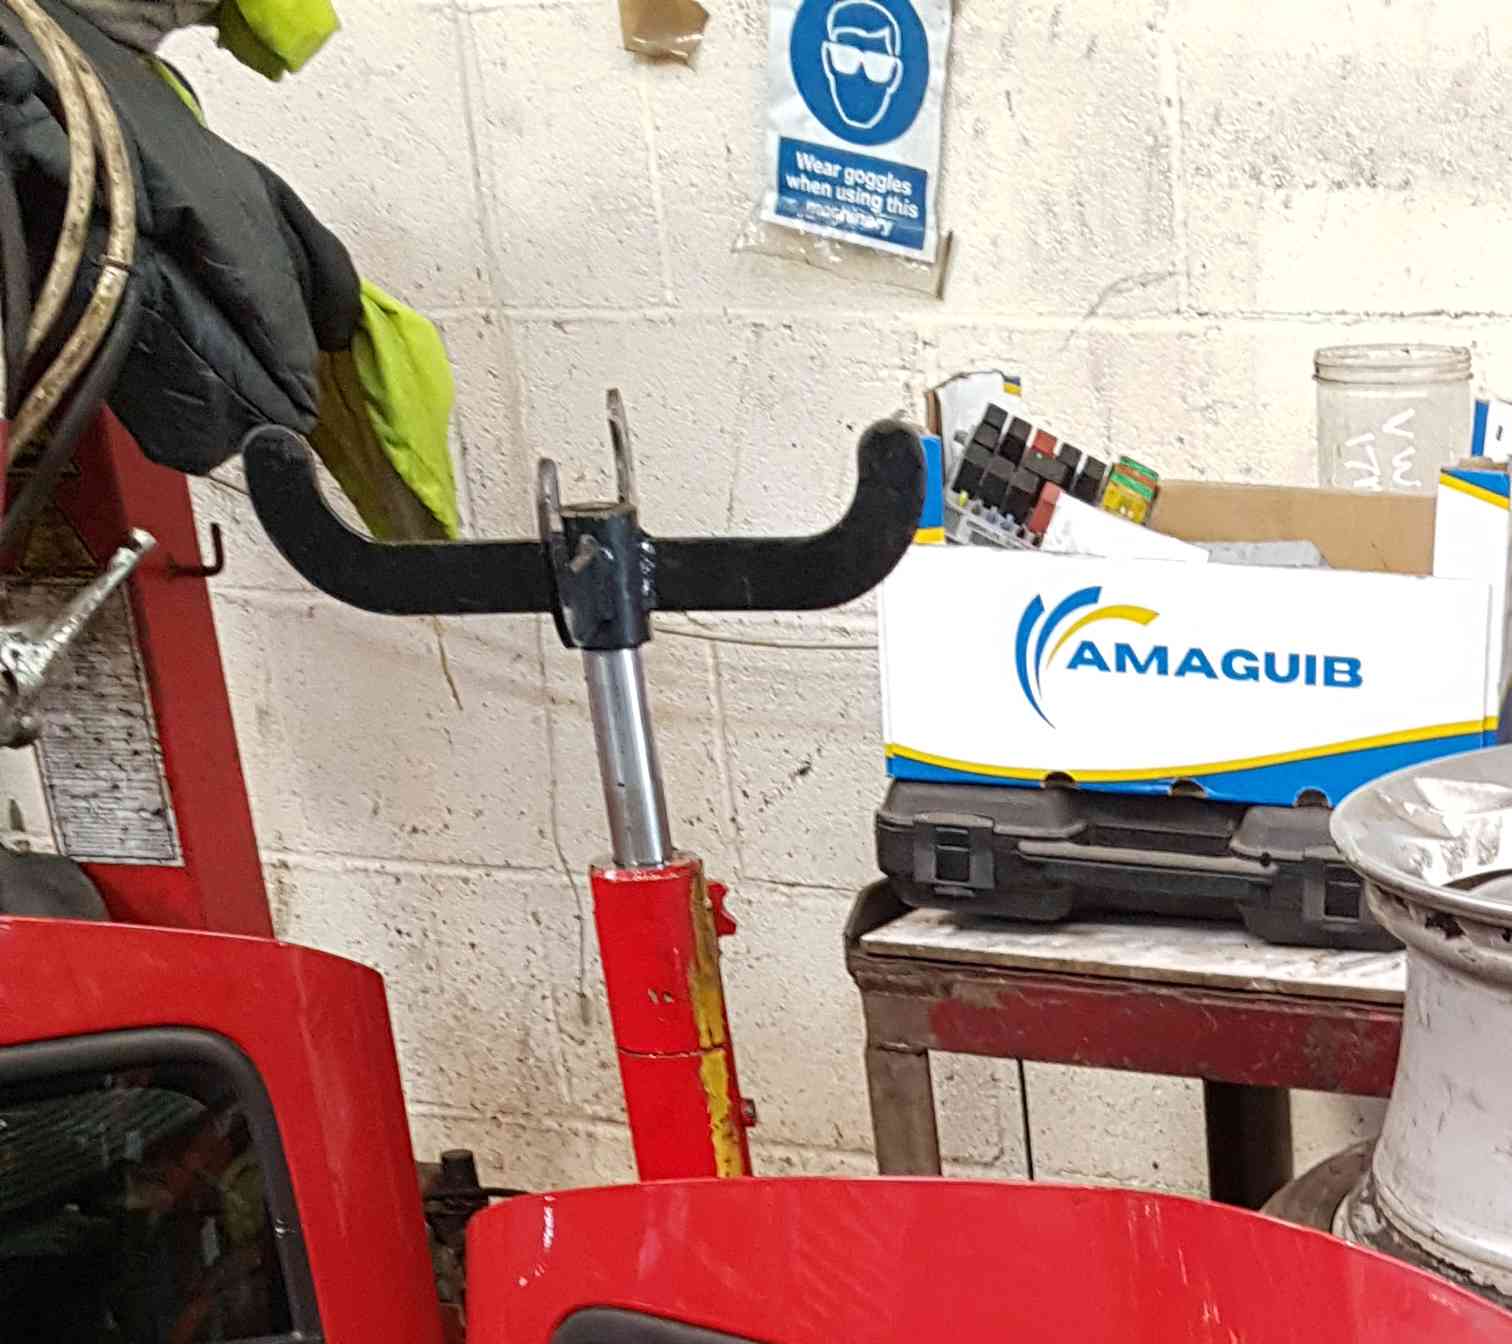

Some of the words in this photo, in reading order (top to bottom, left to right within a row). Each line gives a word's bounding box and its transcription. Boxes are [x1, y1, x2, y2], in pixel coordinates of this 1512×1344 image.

[786, 173, 832, 198] when
[835, 186, 883, 214] using
[886, 196, 919, 219] this
[795, 151, 842, 178] Wear
[844, 167, 912, 196] goggles
[1066, 640, 1363, 689] AMAGUIB
